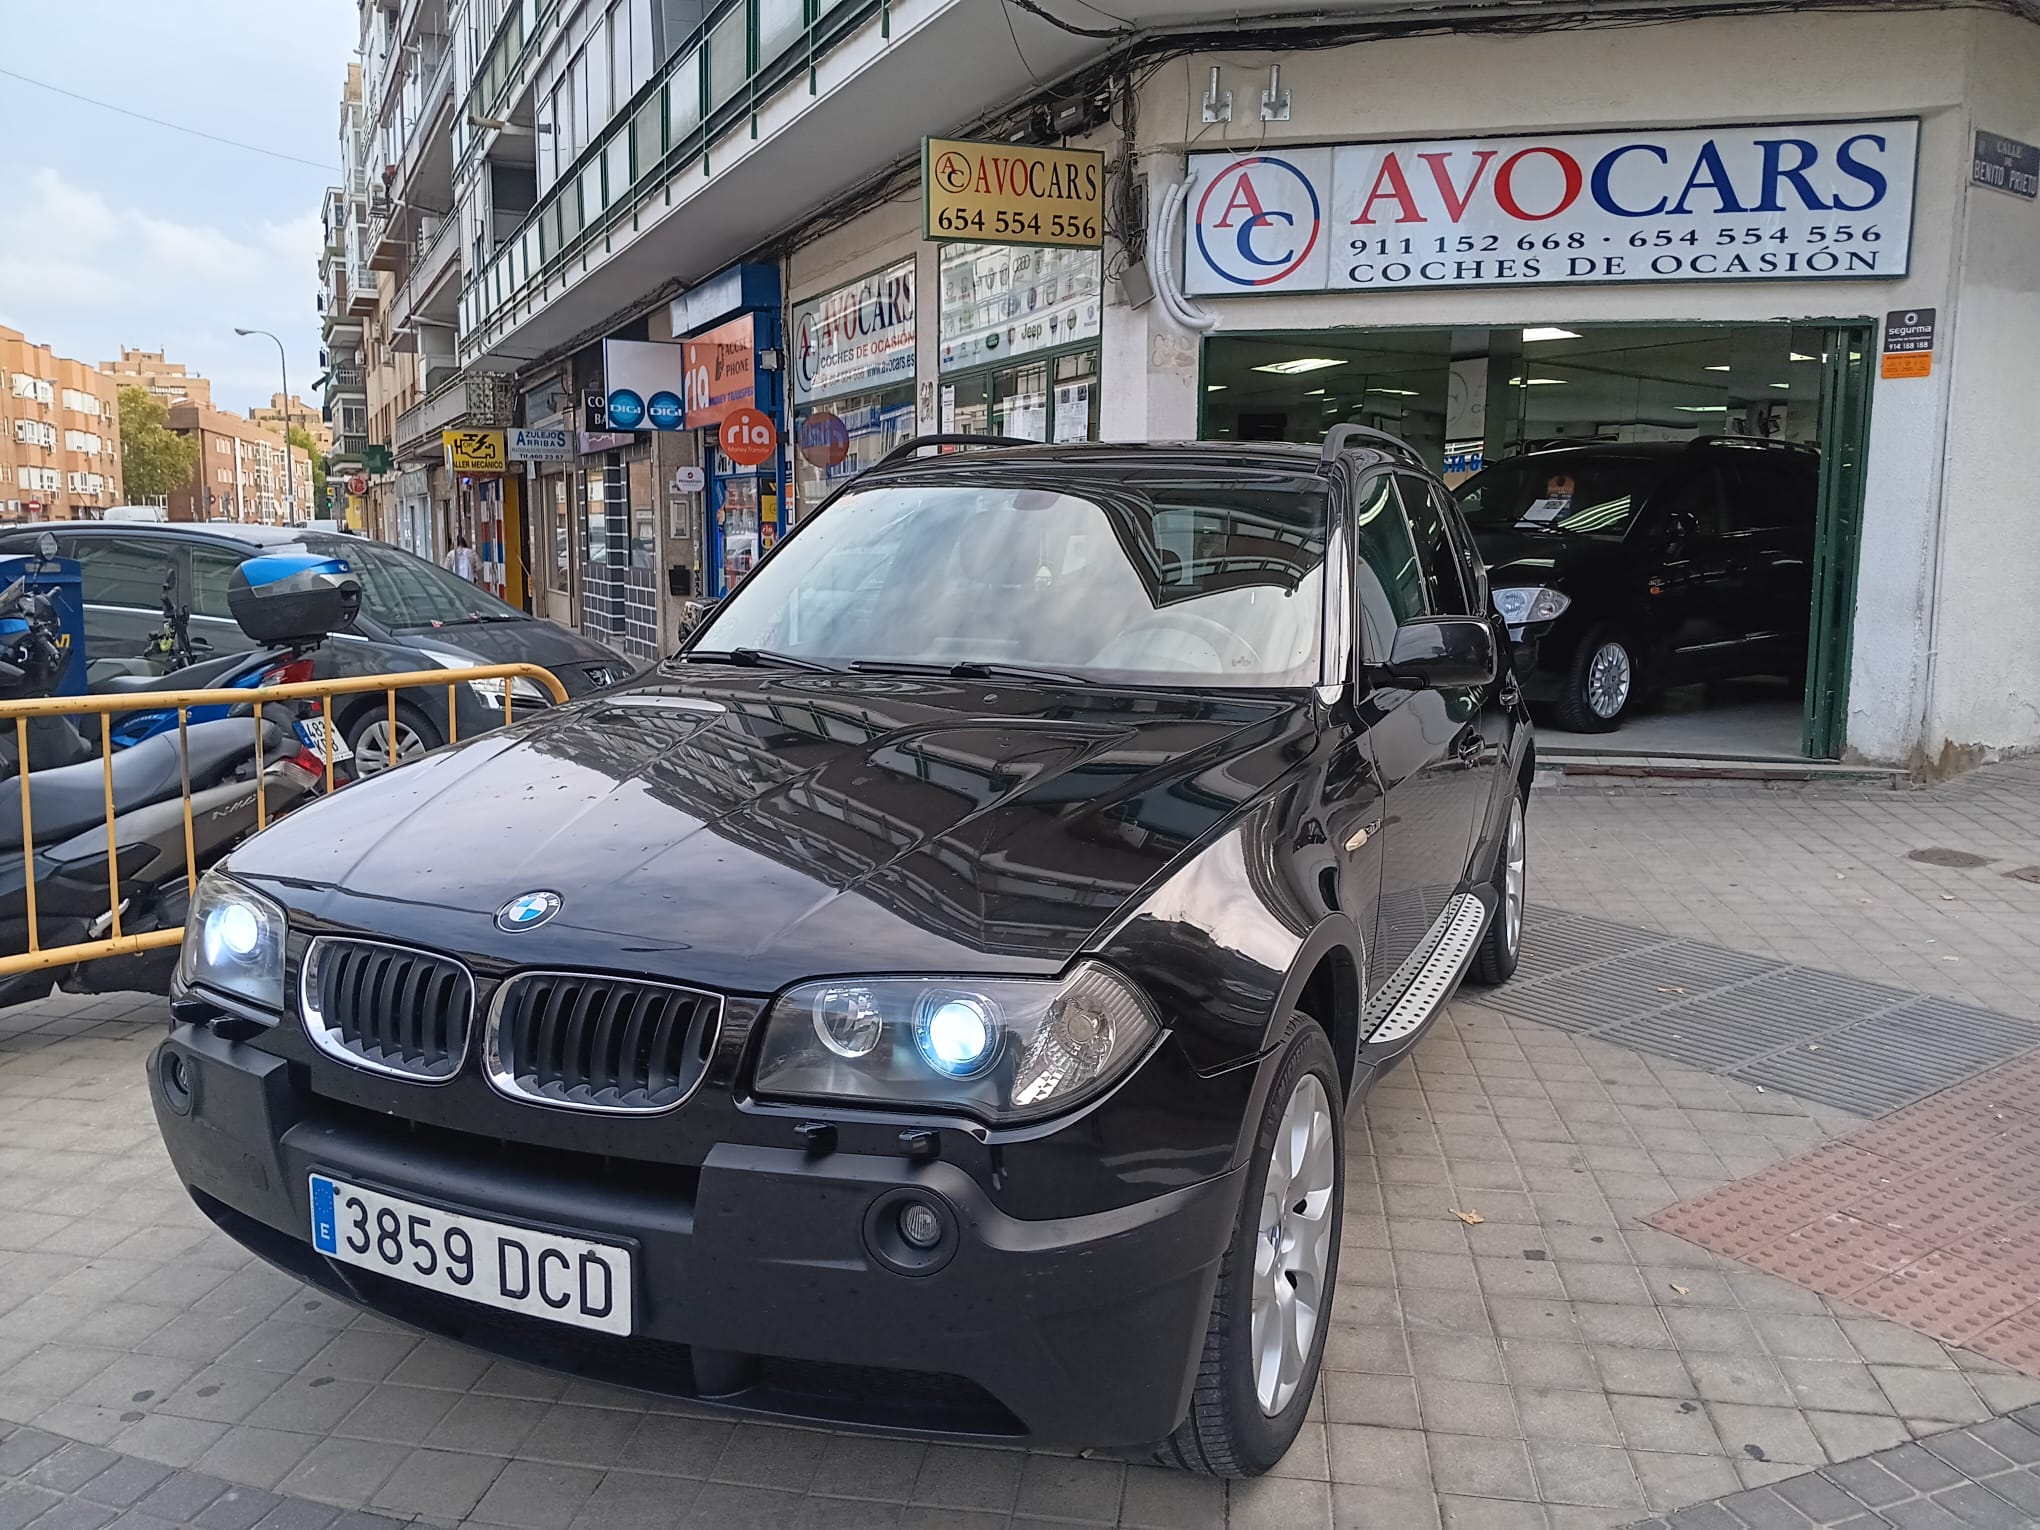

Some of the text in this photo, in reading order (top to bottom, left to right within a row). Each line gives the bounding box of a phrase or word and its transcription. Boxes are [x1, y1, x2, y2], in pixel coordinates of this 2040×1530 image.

[1997, 141, 2022, 158] CALLE
[974, 155, 1097, 201] AVOCARS
[1351, 134, 1887, 225] AVOCARS
[1974, 160, 2037, 194] BENITO PRIETO
[938, 207, 1096, 239] 654 554 556
[1351, 224, 1881, 257] 911 152 668 654 554 556
[1349, 246, 1880, 283] COCHES DE OCASIÓN
[821, 270, 914, 348] AVOCARS
[1021, 322, 1042, 341] Jeep
[1888, 325, 1932, 336] segurma
[726, 358, 749, 377] PHONE
[820, 349, 855, 369] COCHES
[856, 346, 868, 359] DE
[684, 346, 709, 413] ria
[610, 404, 640, 414] DIGI
[650, 407, 682, 417] DIGI
[728, 415, 769, 445] ria
[320, 1197, 612, 1318] E 3859 DCD
